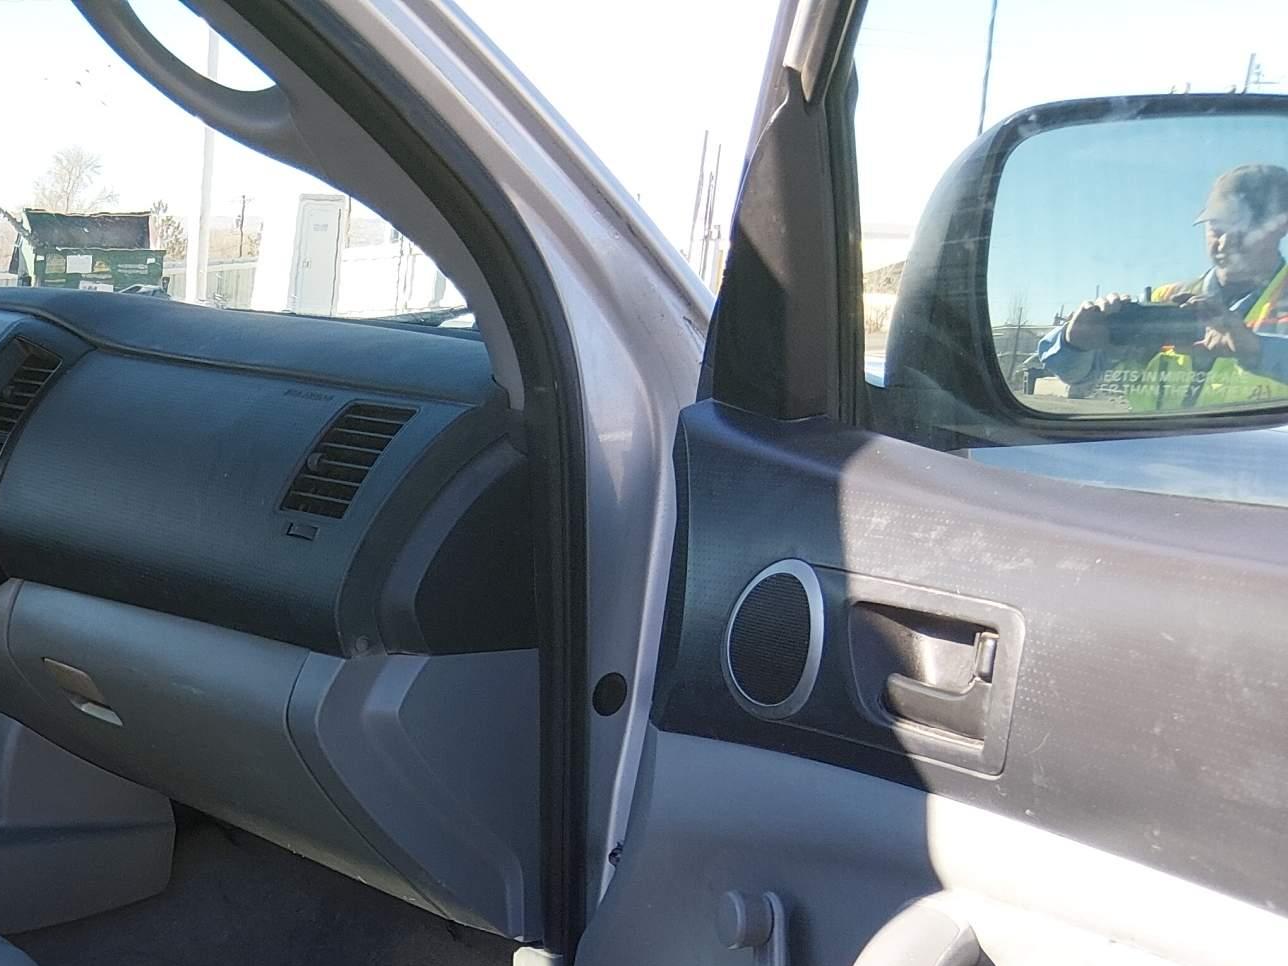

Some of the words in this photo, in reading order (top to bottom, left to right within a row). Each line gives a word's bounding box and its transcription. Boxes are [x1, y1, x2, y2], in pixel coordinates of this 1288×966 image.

[1141, 371, 1158, 382] IN
[1123, 384, 1159, 395] THAN
[1163, 384, 1199, 396] THEY
